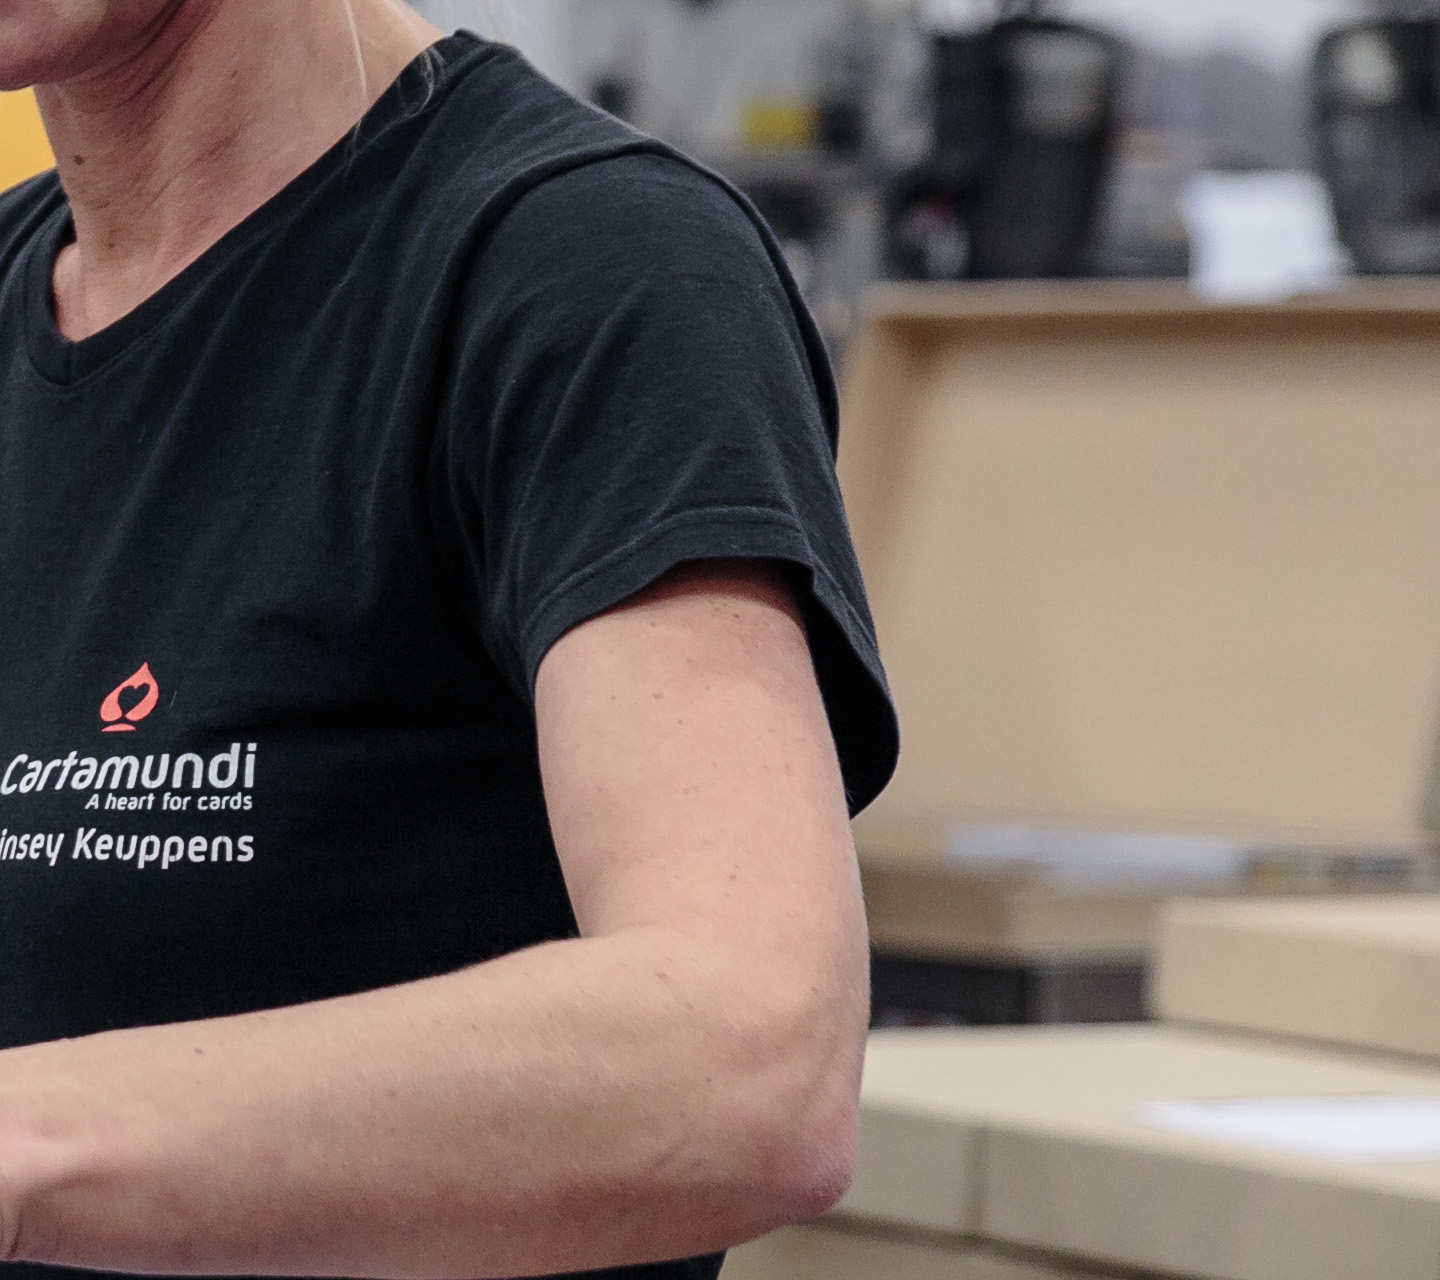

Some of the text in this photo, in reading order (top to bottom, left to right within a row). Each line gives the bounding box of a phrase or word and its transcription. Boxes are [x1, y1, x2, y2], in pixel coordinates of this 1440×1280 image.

[0, 742, 258, 795] Cartamundi
[84, 790, 254, 811] A heart for cards
[71, 826, 255, 870] Keuppens
